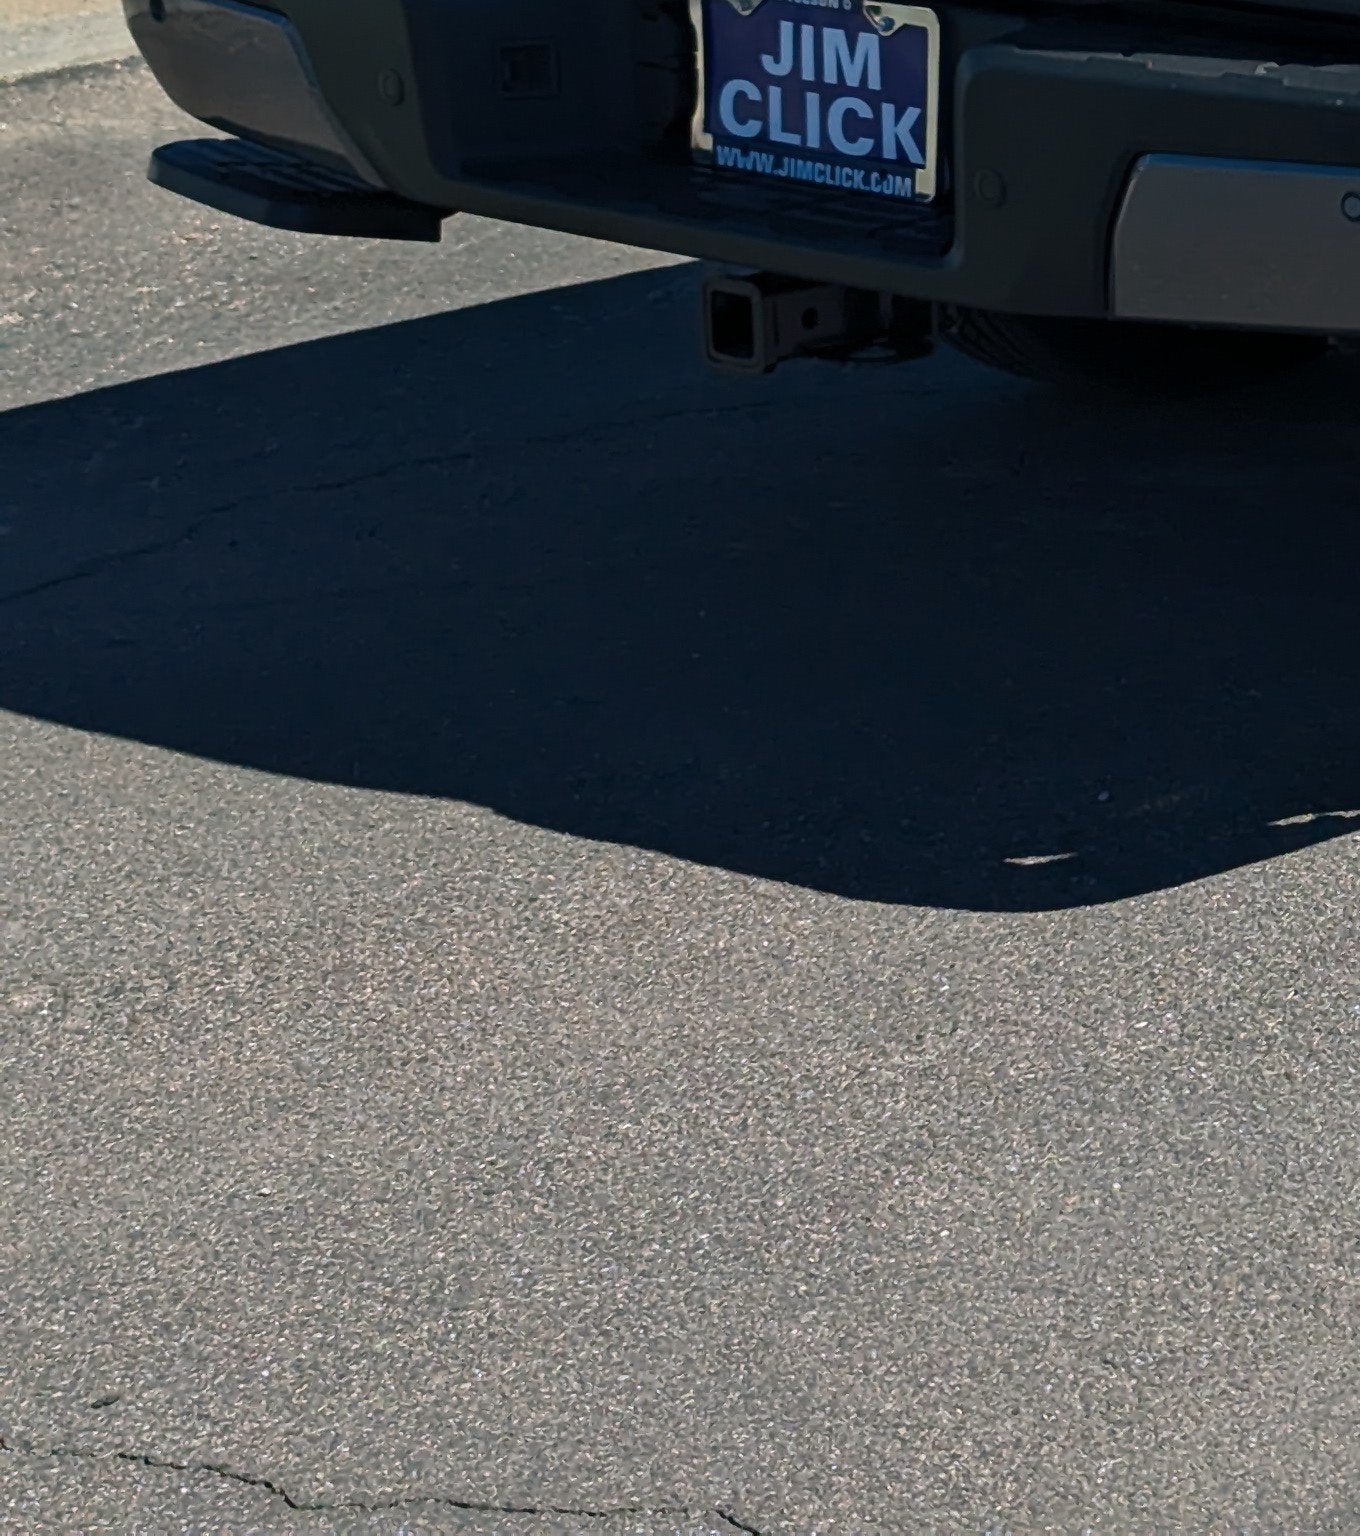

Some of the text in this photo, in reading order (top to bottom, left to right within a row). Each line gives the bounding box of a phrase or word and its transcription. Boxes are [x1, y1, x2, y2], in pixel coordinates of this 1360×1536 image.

[760, 19, 882, 92] JIM
[718, 78, 926, 166] CLICK
[715, 144, 913, 199] WWW.JIMCLICK.COM
